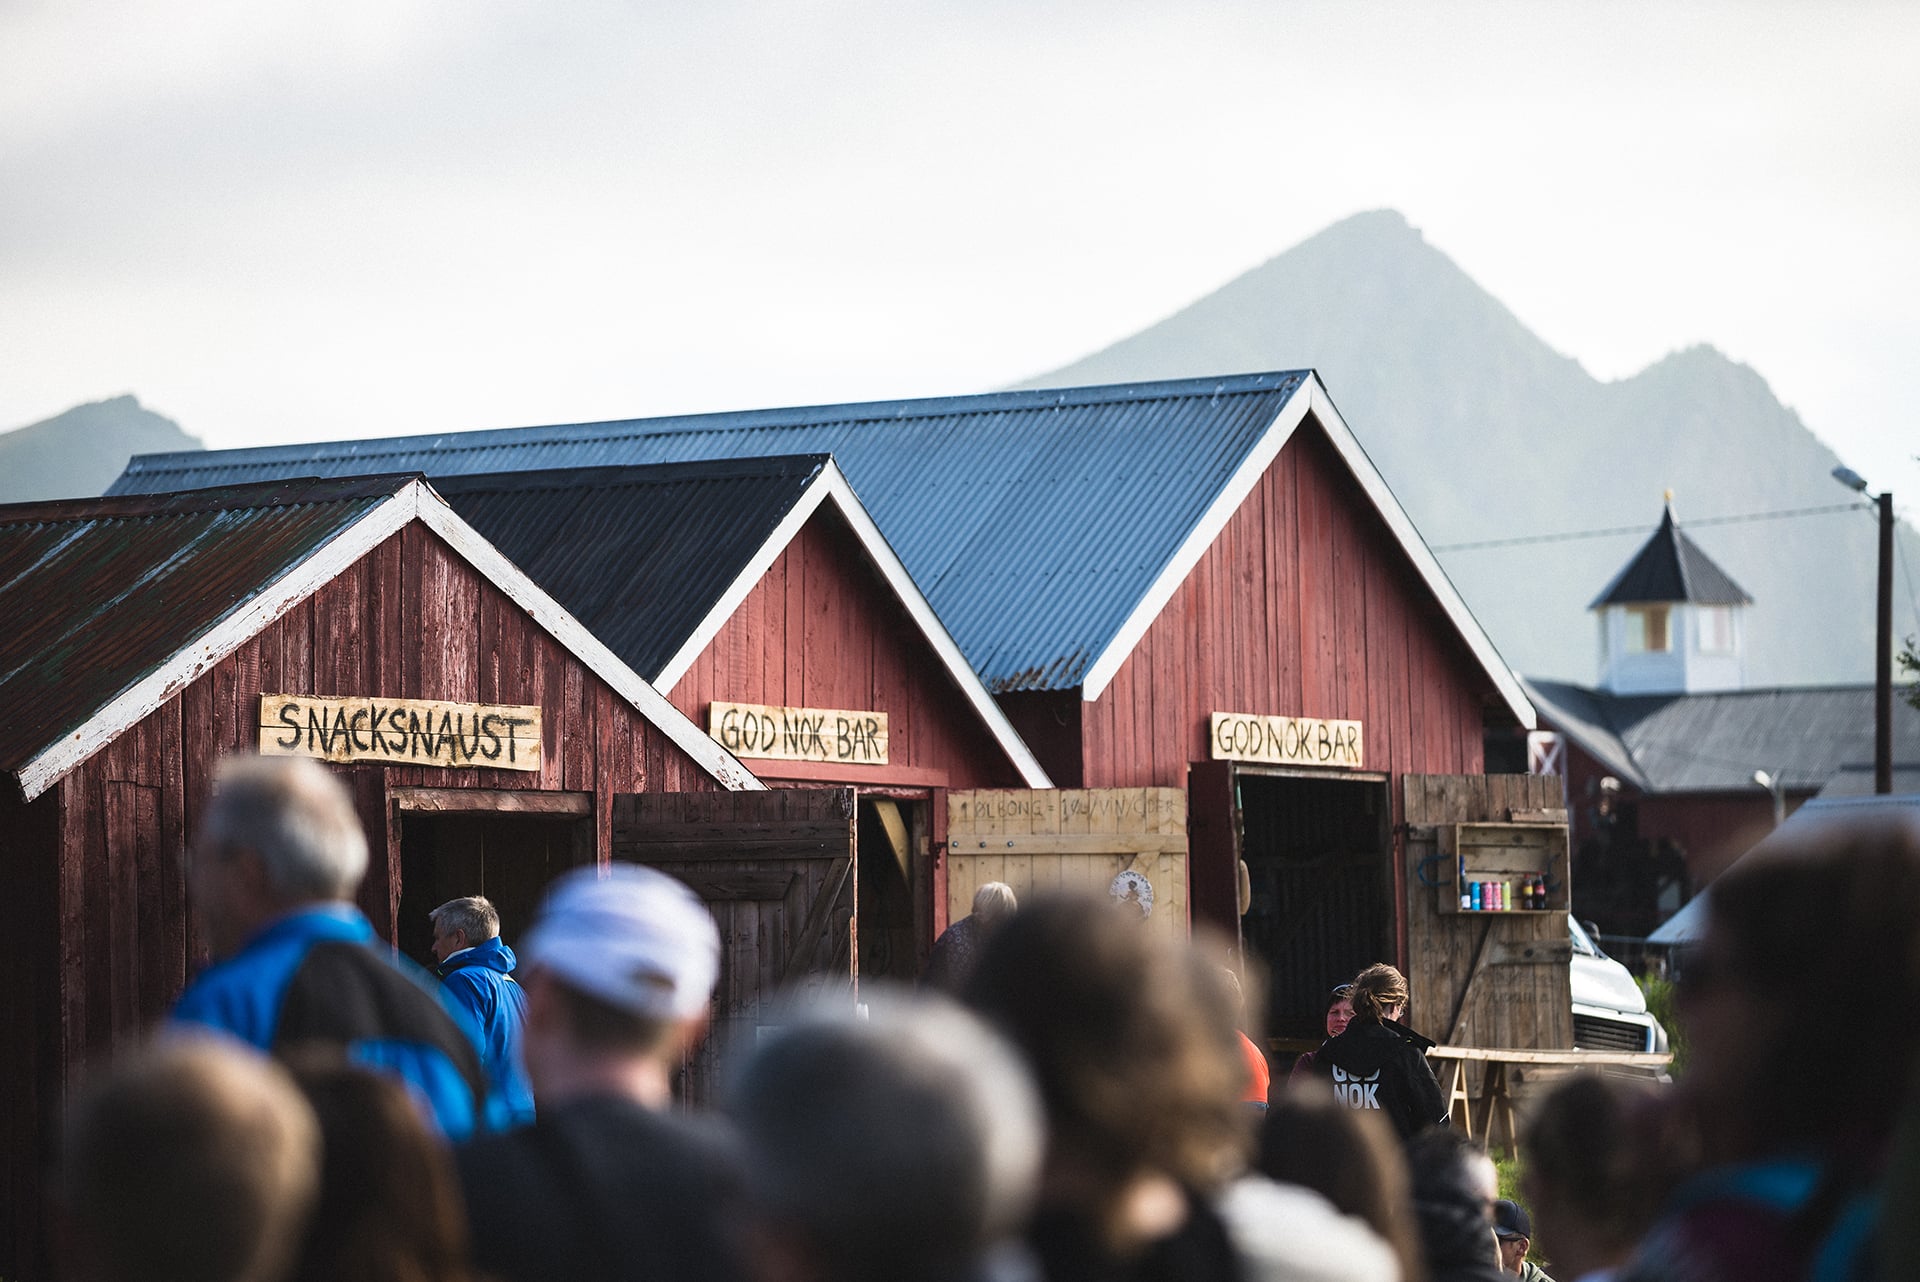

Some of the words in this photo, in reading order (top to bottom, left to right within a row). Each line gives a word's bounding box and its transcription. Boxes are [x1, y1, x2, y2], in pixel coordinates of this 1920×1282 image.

[277, 702, 534, 763] SNACKSNAUST
[720, 708, 777, 751] GOD
[783, 713, 828, 756] NOK
[836, 716, 882, 760] BAR
[1217, 717, 1263, 755] GOD
[1267, 721, 1313, 759] NOK
[1318, 724, 1359, 763] BAR
[1333, 1083, 1380, 1110] NOK
